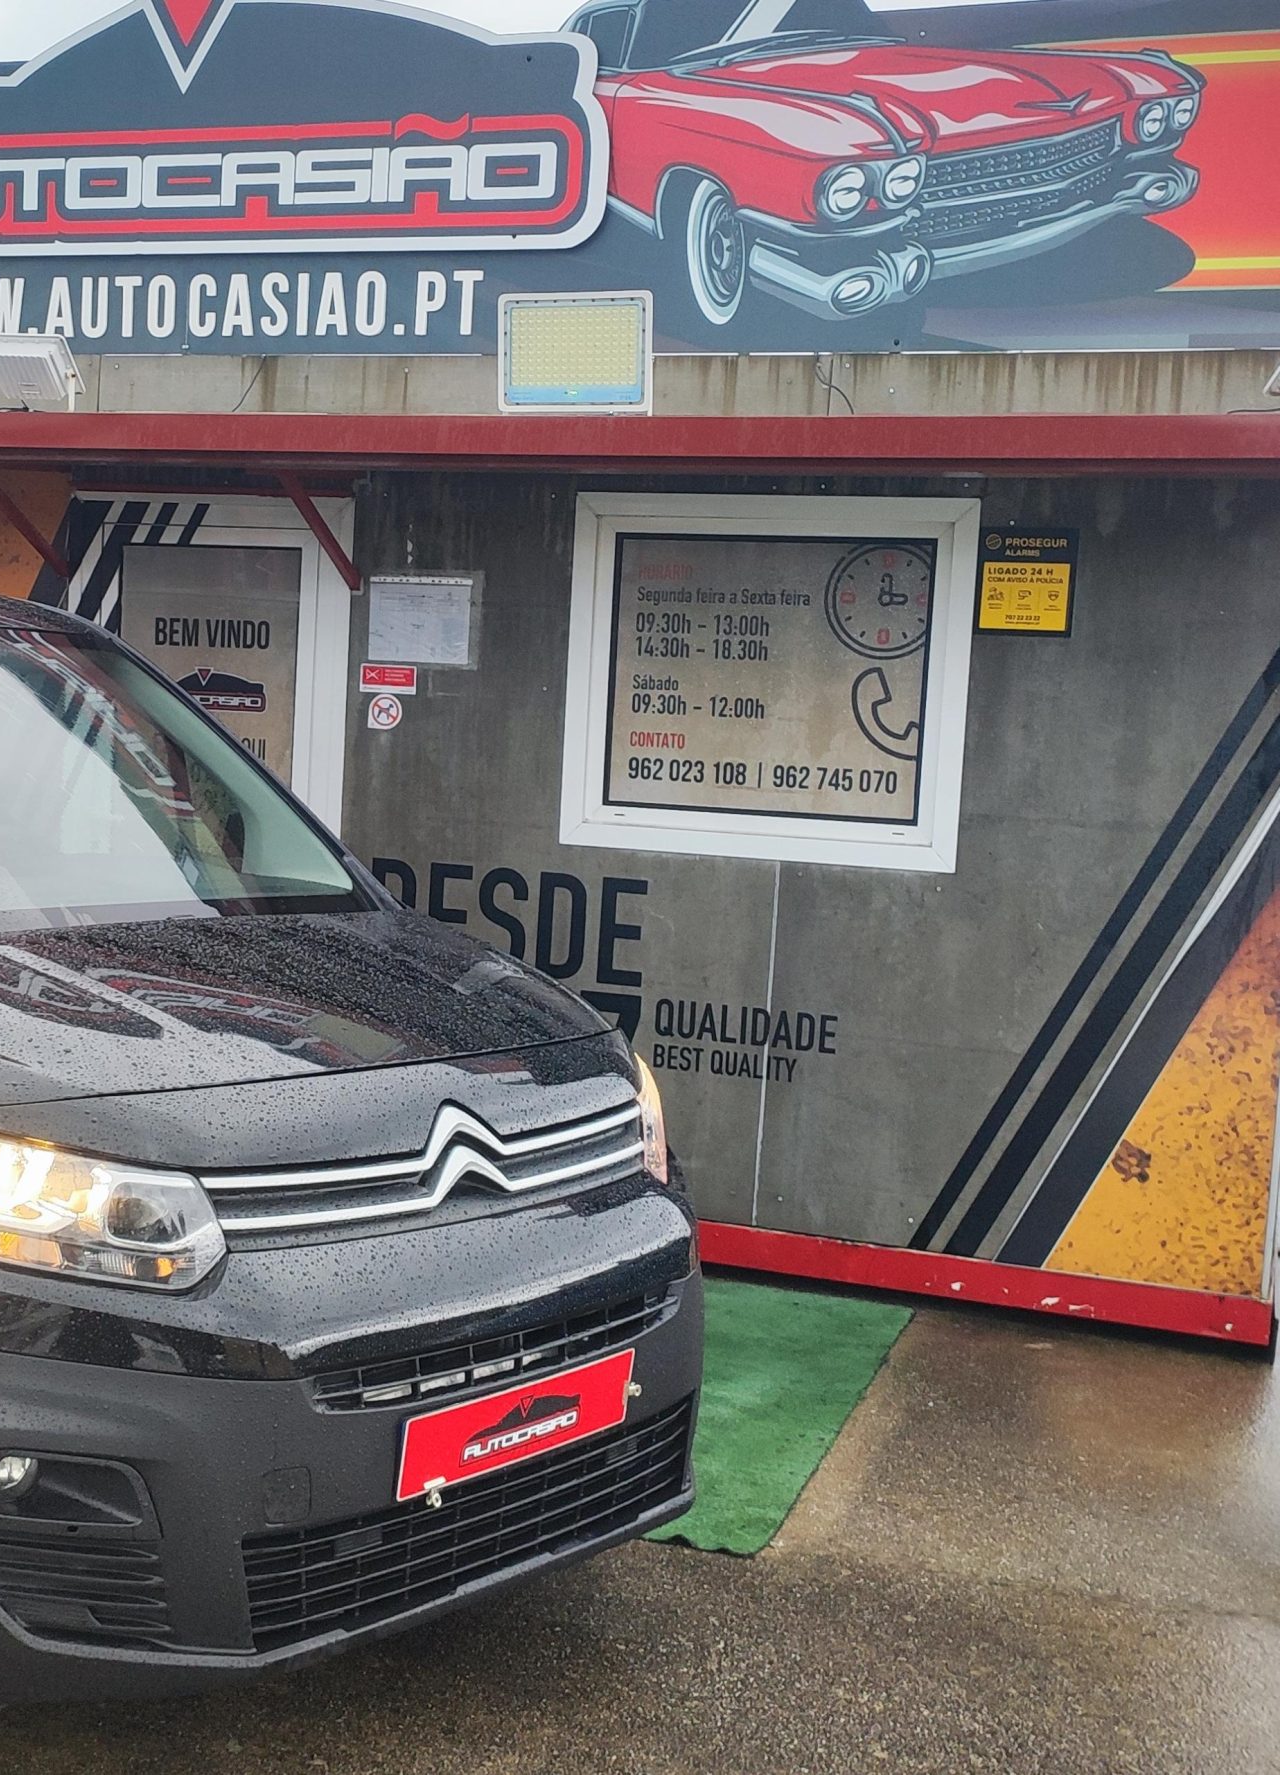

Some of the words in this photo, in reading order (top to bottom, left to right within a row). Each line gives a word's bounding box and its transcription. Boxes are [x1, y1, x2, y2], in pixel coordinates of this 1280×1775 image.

[1005, 538, 1068, 548] PROSEGUR
[1005, 549, 1040, 557] ALARMS
[637, 586, 692, 606] Segunda
[696, 588, 725, 604] feira
[729, 592, 737, 604] a
[741, 588, 776, 606] Sexta
[780, 589, 811, 606] feira
[155, 617, 199, 647] BEM
[206, 619, 270, 649] VINDO
[636, 612, 691, 634] 09:30h
[714, 614, 770, 637] 13:00h
[636, 636, 690, 659] 14:30h
[632, 674, 679, 691] Sábado
[632, 693, 687, 715] 09:30h
[710, 696, 765, 719] 12:00h
[630, 731, 685, 749] CONTATO
[628, 757, 664, 781] 962
[669, 759, 705, 783] 023
[713, 762, 747, 785] 108
[773, 765, 810, 789] 962
[817, 766, 853, 792] 745
[859, 770, 897, 794] 070
[655, 998, 838, 1054] QUALIDADE
[653, 1043, 704, 1072] BEST
[710, 1050, 797, 1083] QUALITY
